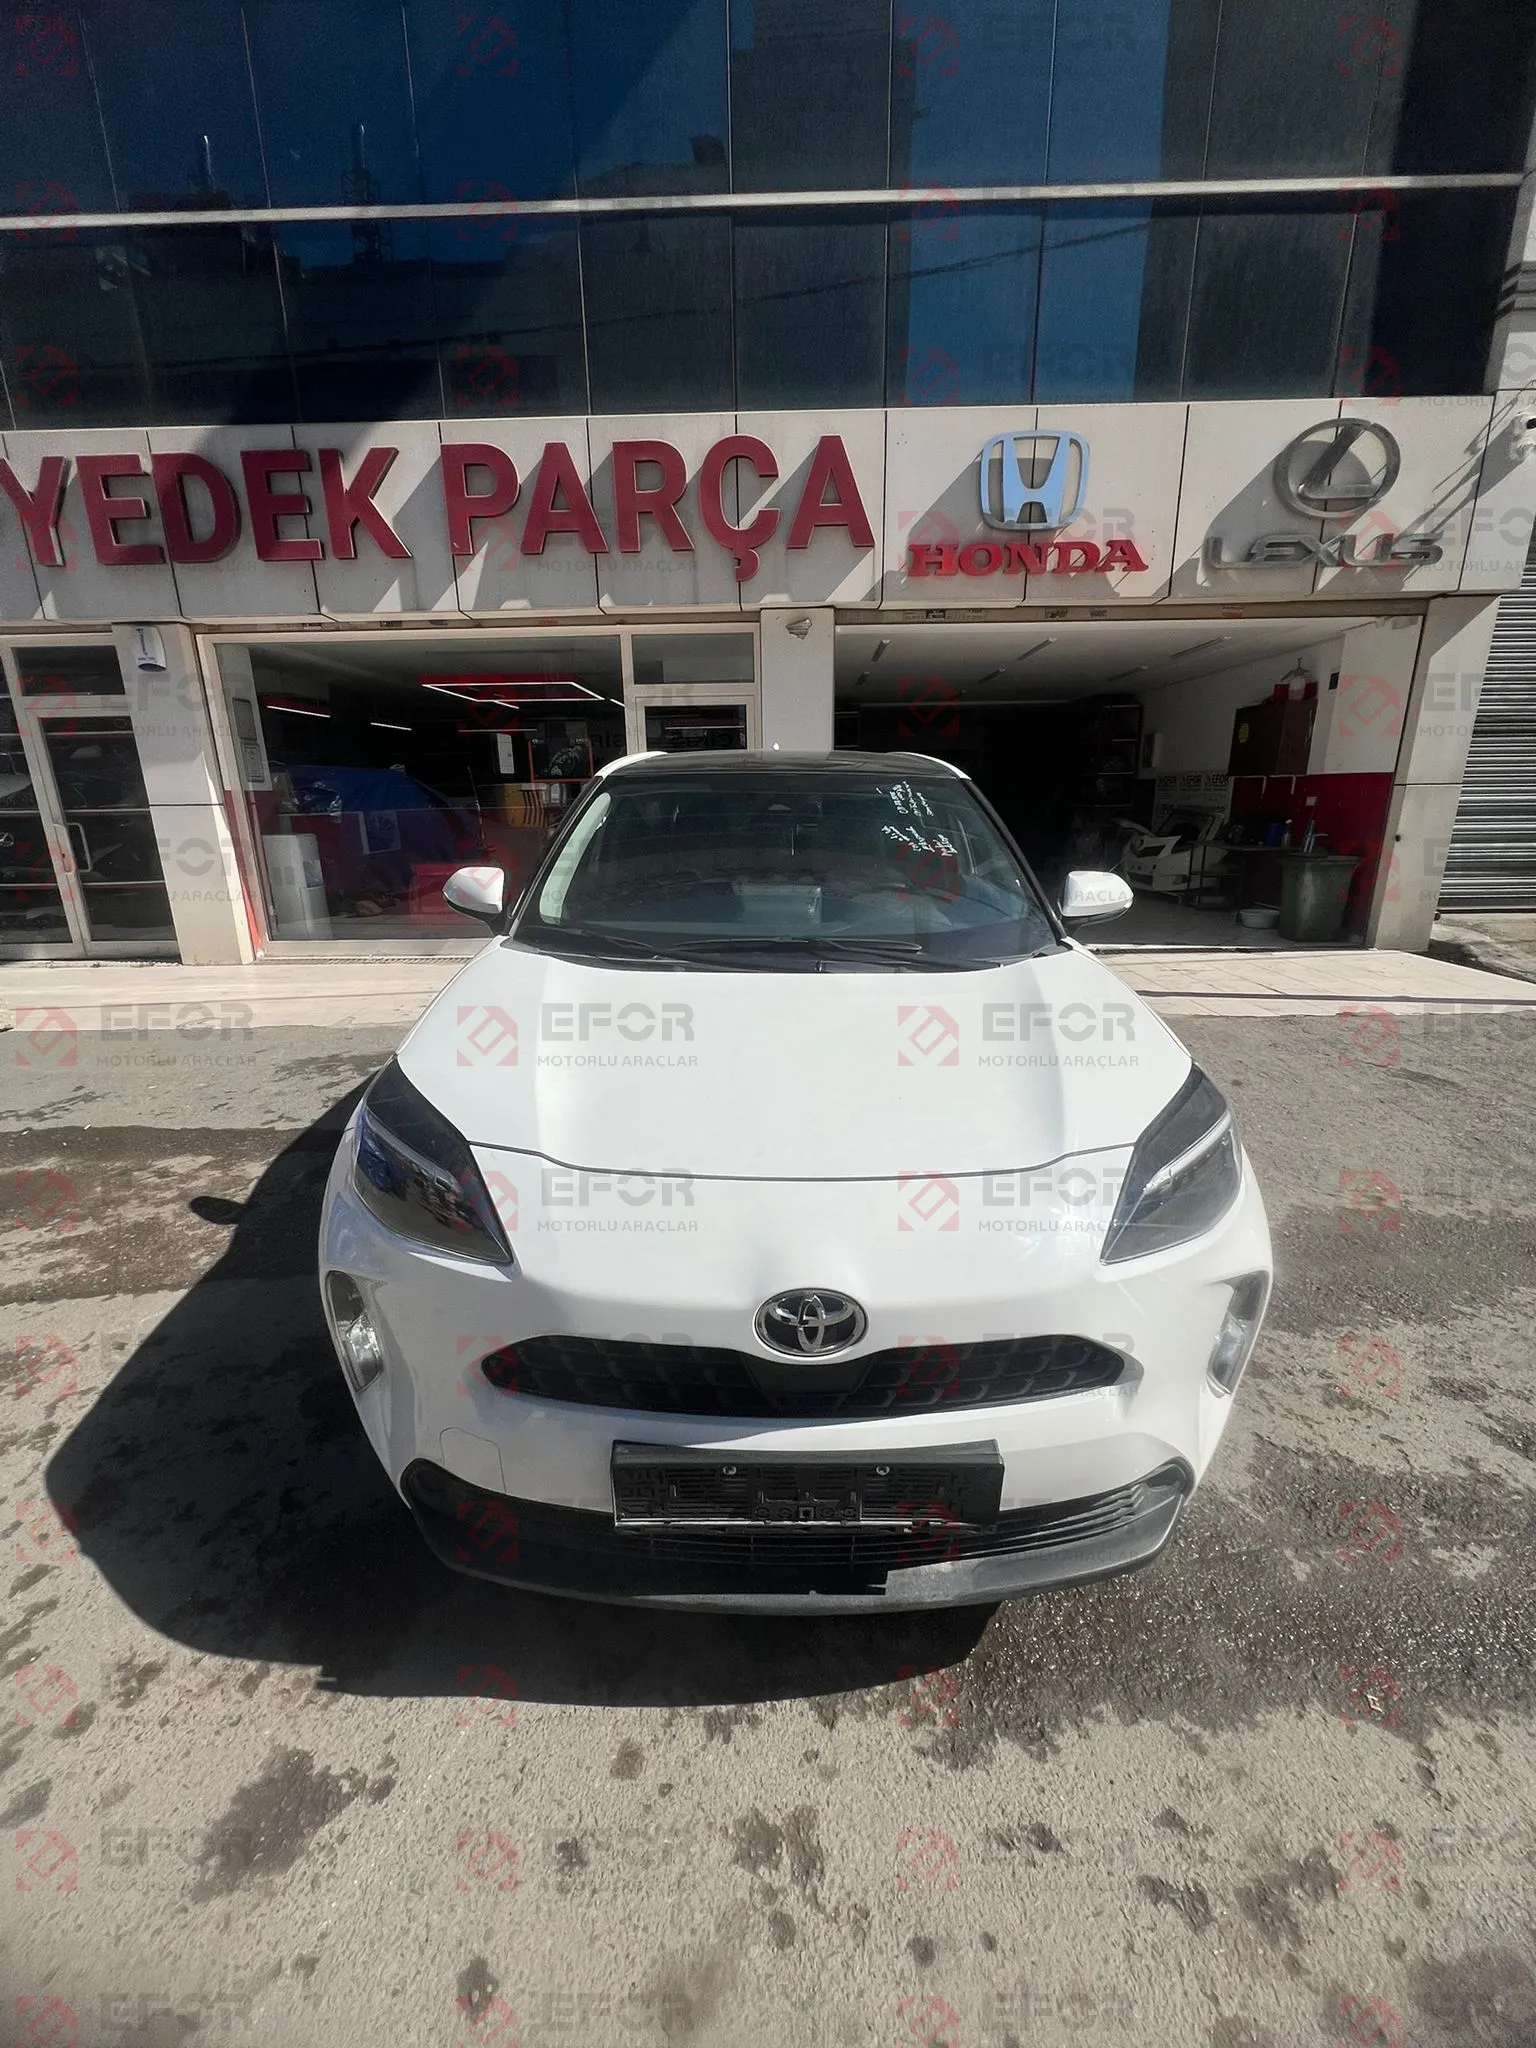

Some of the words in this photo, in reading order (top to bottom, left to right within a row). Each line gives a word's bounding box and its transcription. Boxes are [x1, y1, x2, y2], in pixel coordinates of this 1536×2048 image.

[0, 447, 412, 567] YEDEK
[440, 433, 876, 582] PARÇA
[906, 539, 1149, 578] HONDA
[1205, 531, 1445, 570] LEXUS
